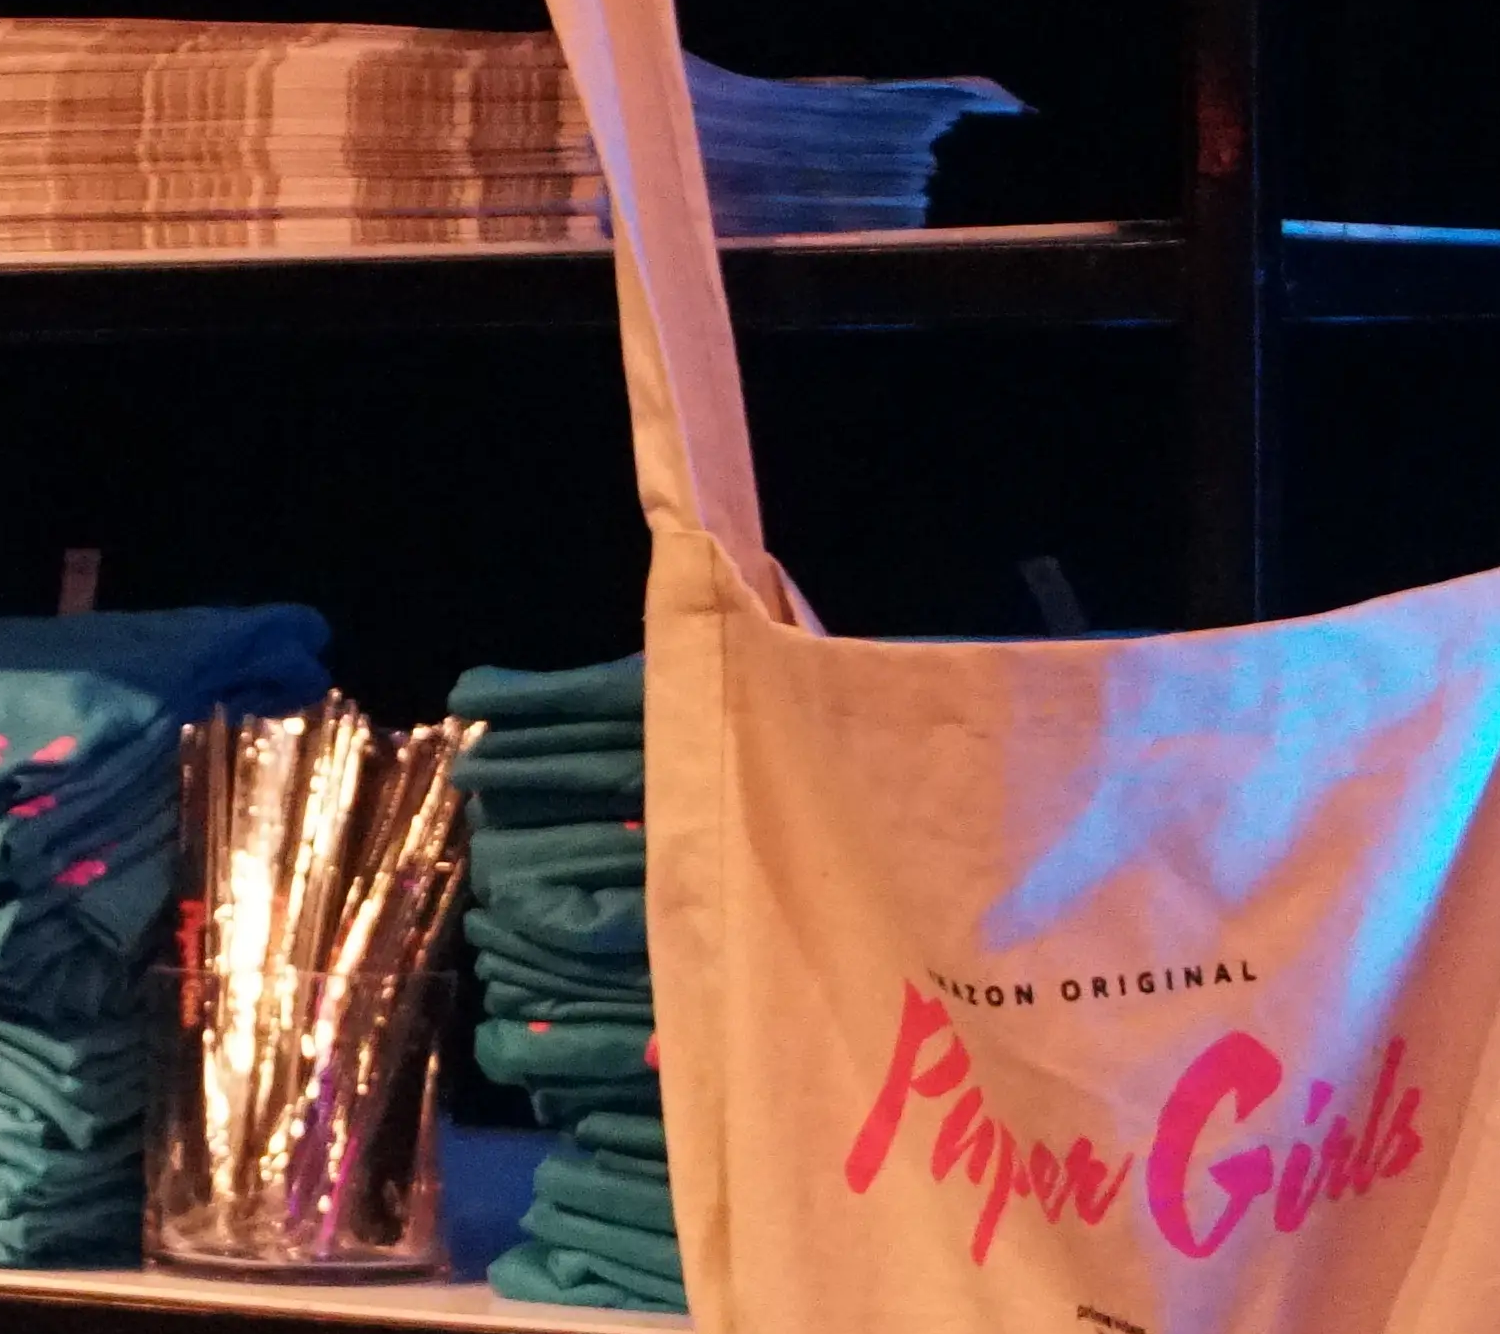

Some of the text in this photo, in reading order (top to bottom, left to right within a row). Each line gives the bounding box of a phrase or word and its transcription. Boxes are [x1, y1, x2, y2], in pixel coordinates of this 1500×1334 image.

[1060, 960, 1258, 1002] ORIGINAL
[845, 979, 1423, 1267] Paper Girls
